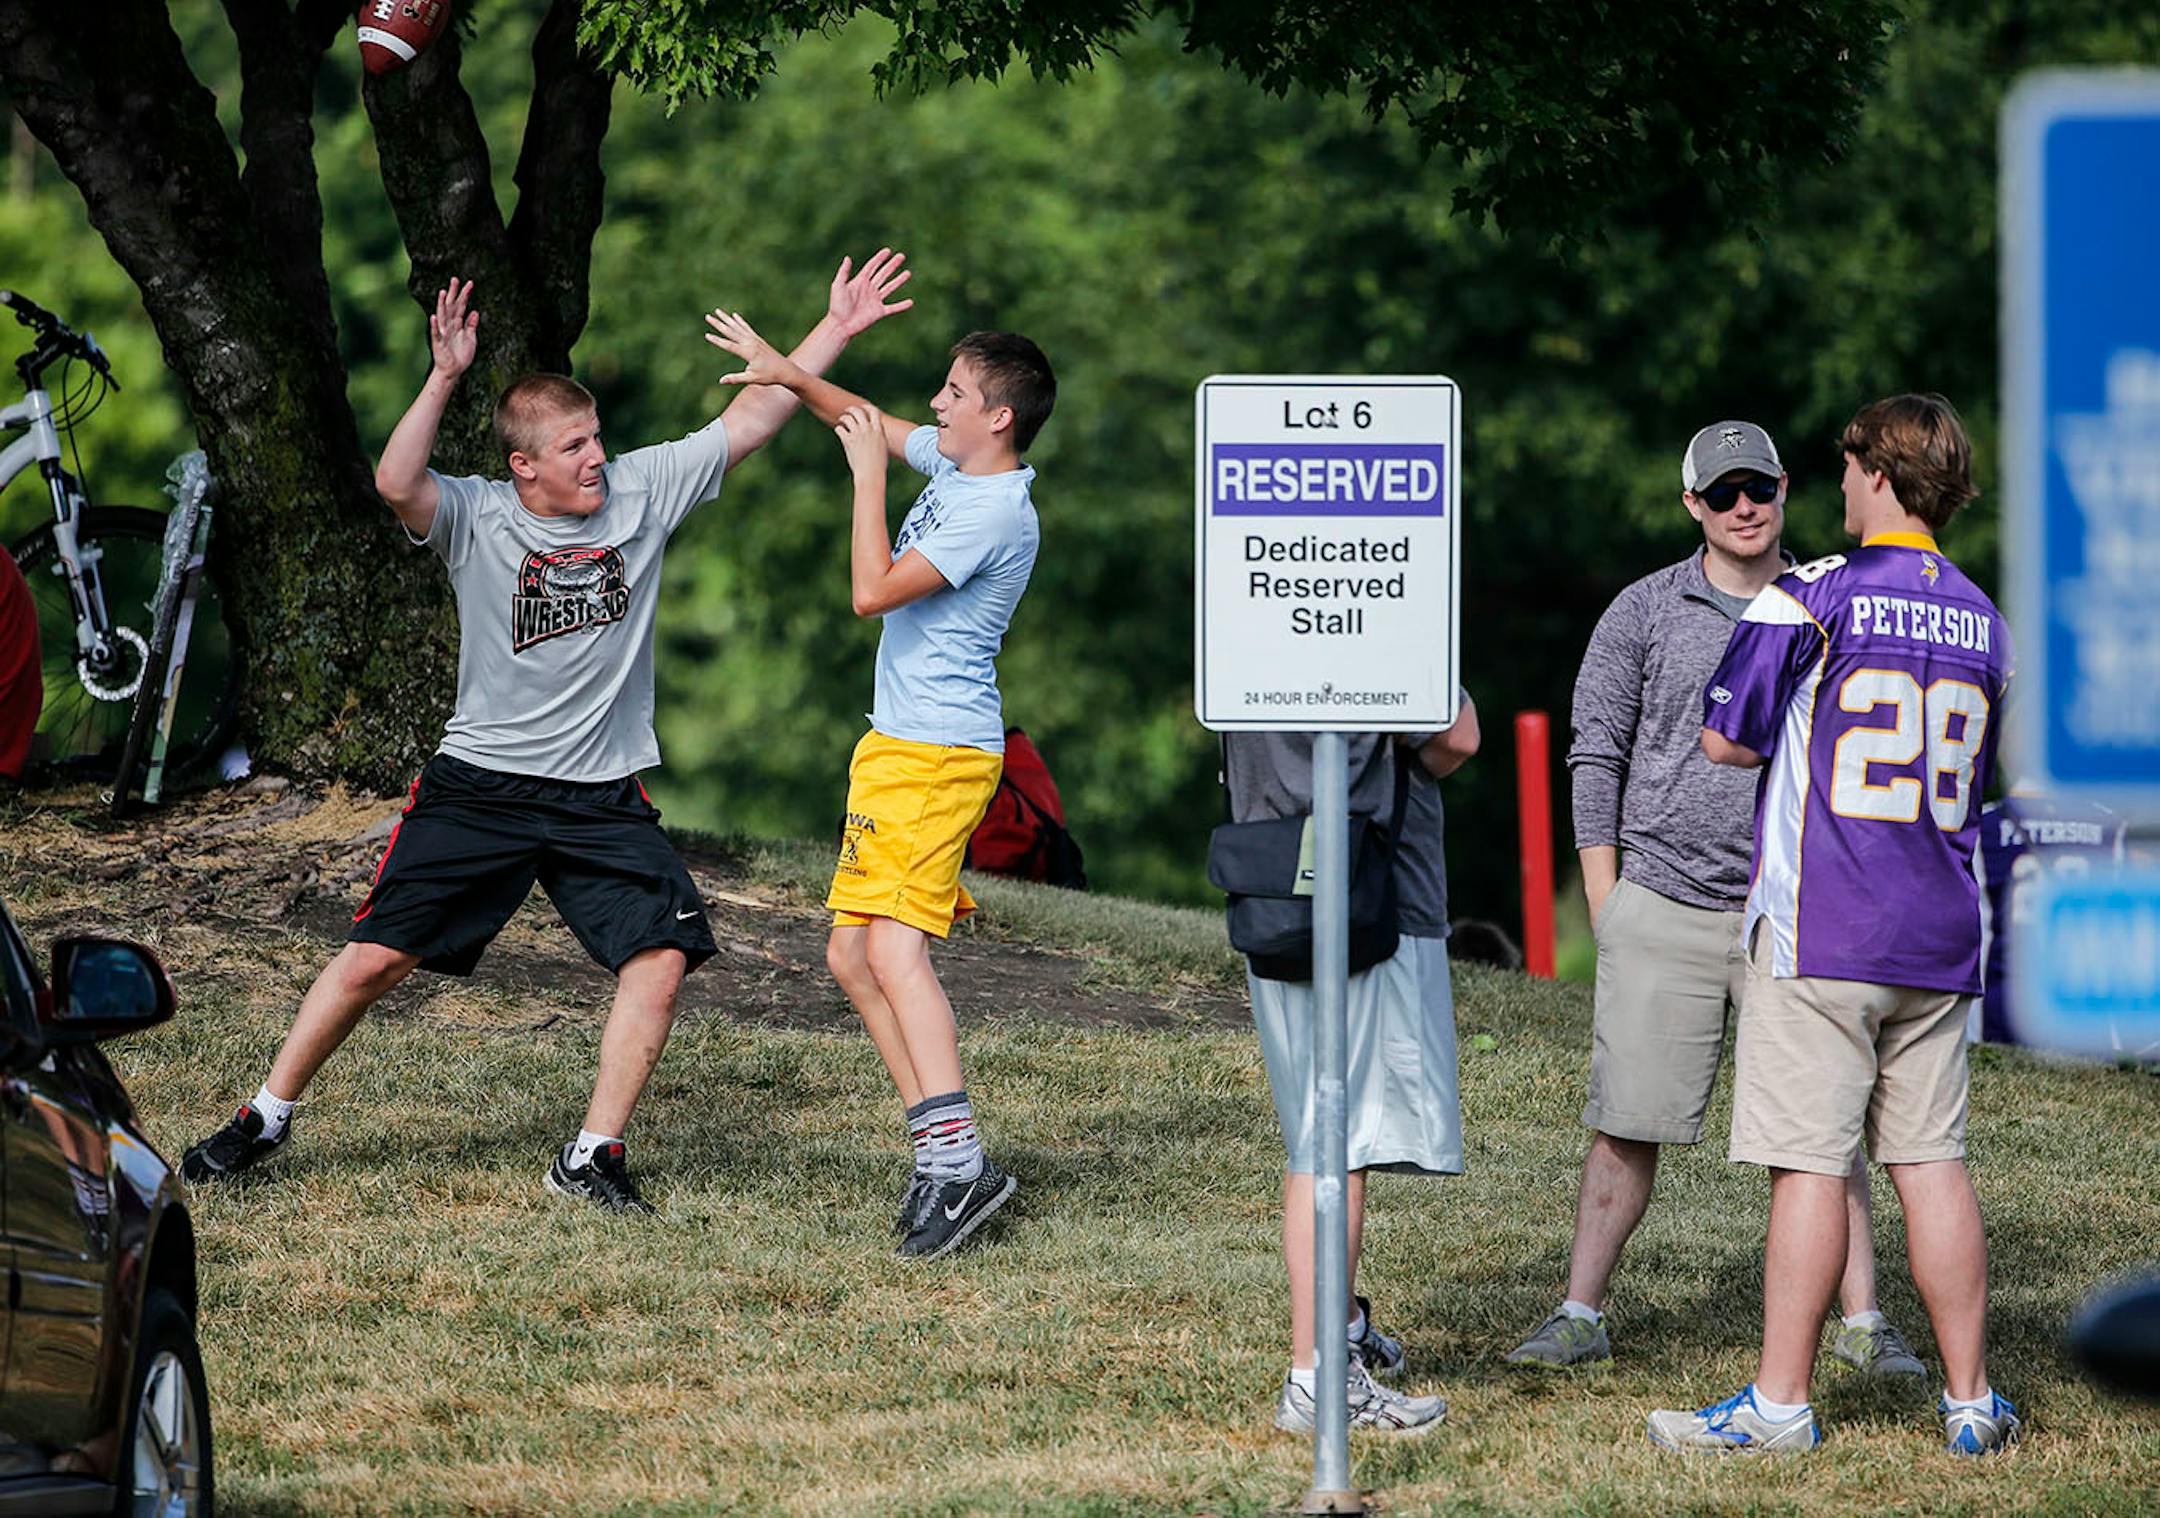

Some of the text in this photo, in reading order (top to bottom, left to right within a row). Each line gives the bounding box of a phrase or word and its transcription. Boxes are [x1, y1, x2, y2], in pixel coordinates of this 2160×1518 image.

[1284, 400, 1372, 430] Lot 6
[1218, 458, 1438, 502] RESERVED
[1244, 535, 1410, 563] Dedicated
[1249, 571, 1405, 599] Reserved
[1291, 607, 1363, 635] Stall
[1851, 595, 1991, 653] PETERSON
[1244, 691, 1409, 706] 24 HOUR ENFORCEMENT
[1830, 668, 1990, 832] 28
